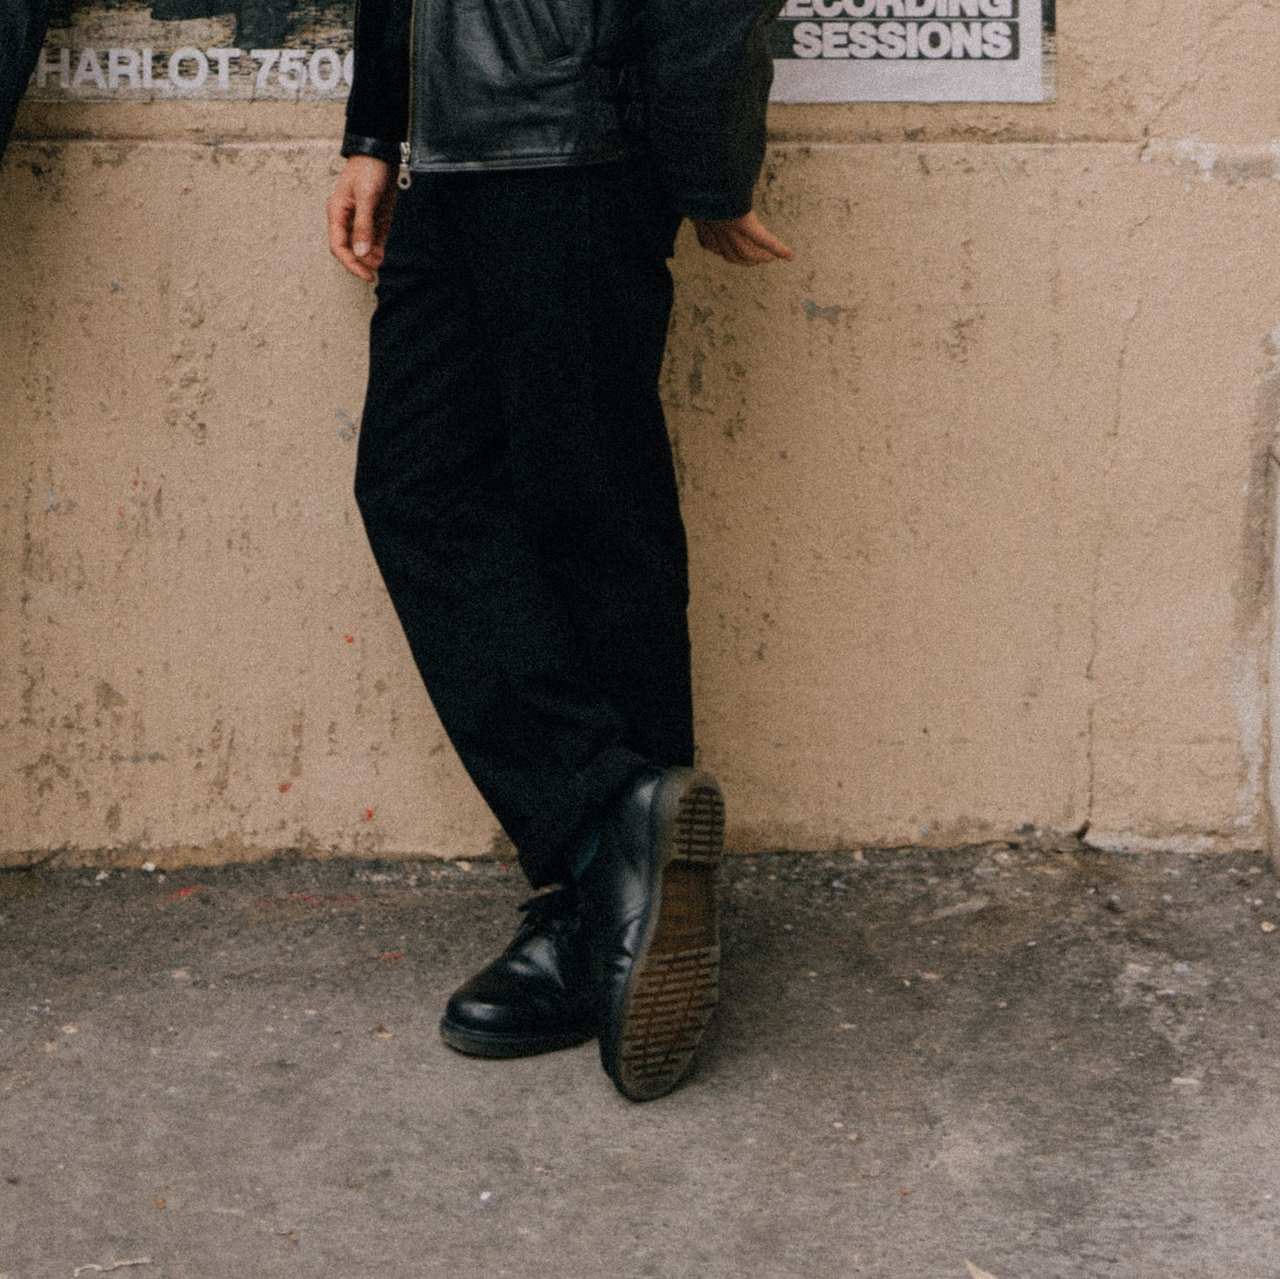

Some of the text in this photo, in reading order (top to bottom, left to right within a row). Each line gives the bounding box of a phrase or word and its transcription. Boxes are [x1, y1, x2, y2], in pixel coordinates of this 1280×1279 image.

[792, 21, 1013, 59] SESSIONS
[28, 46, 354, 91] HARLOT 750
